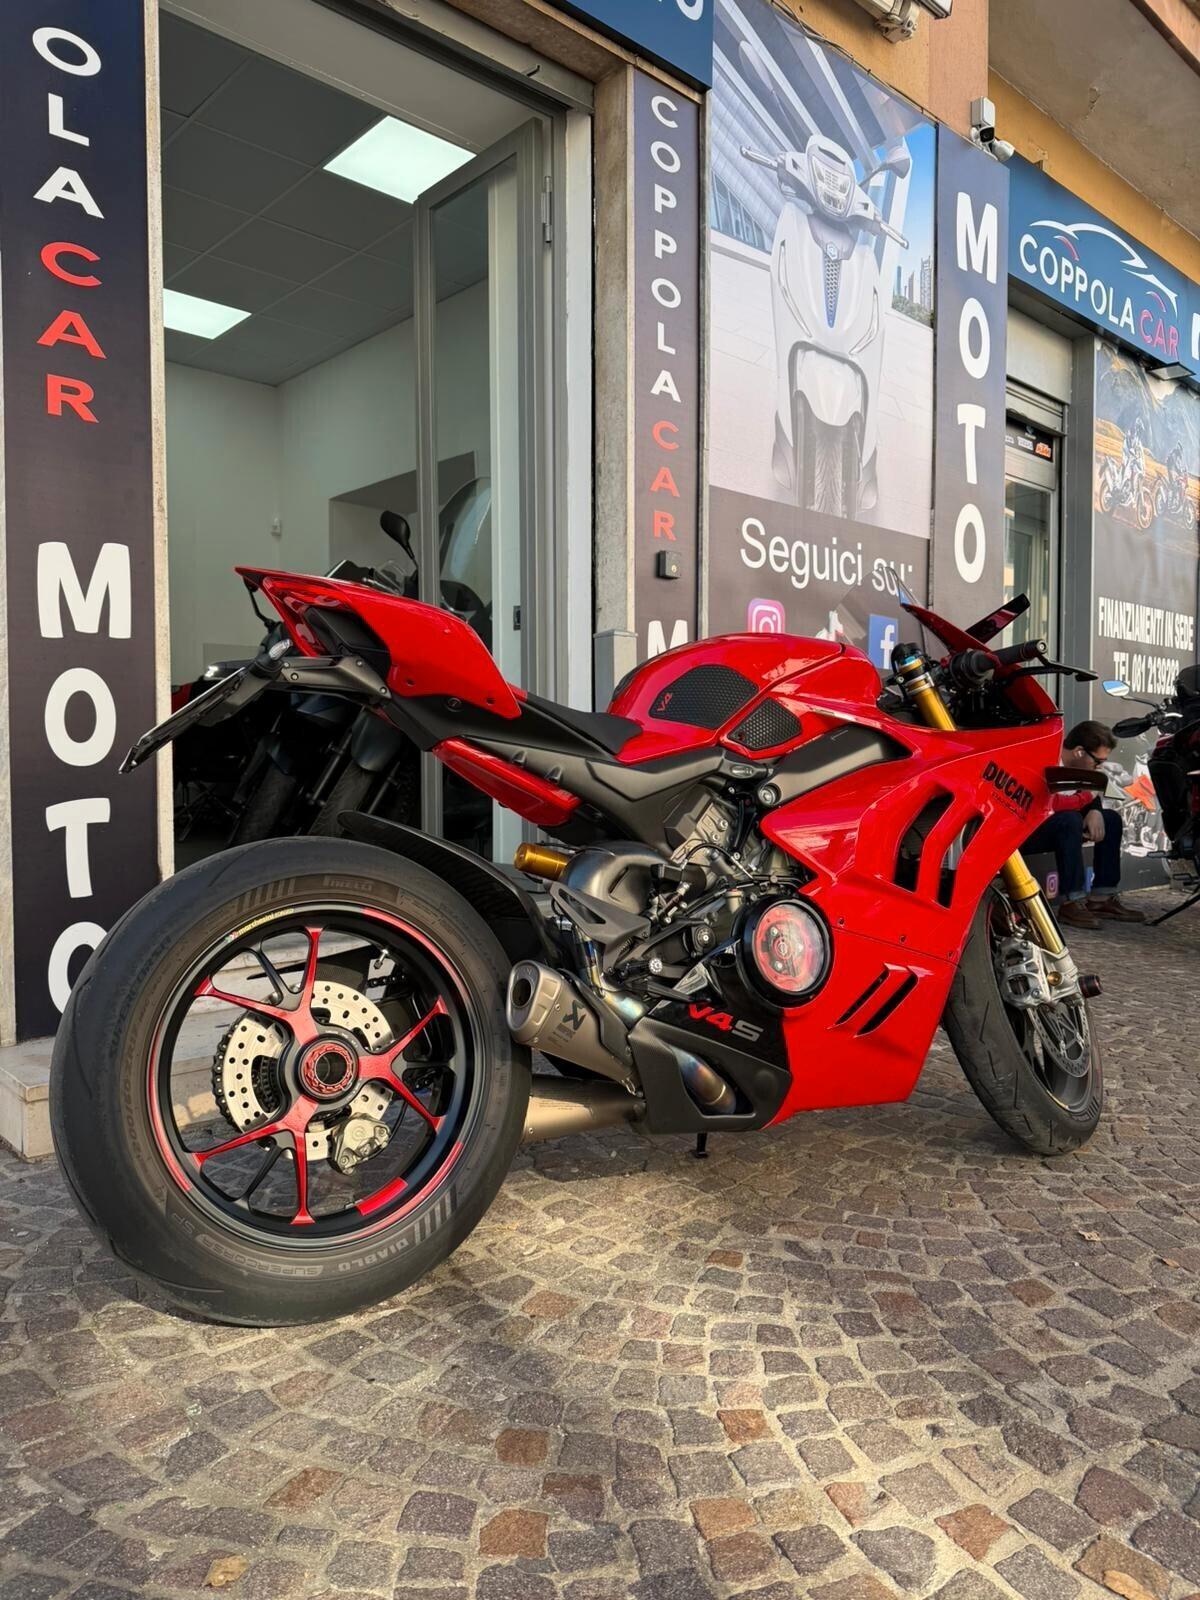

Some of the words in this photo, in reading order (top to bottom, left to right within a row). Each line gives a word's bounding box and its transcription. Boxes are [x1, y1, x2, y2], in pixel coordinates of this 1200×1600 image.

[650, 95, 682, 402] COPPOLA
[36, 241, 107, 423] CAR
[1019, 233, 1135, 335] COPPOLA
[1138, 309, 1179, 362] CAR
[954, 191, 998, 583] MOTO
[650, 420, 681, 541] CAR
[740, 517, 863, 589] Seguici
[1098, 596, 1164, 646] FINANZIAMENTI
[1165, 610, 1174, 648] IN
[1175, 612, 1194, 651] SEDE
[1113, 651, 1131, 685] TEL
[1131, 653, 1146, 693] 081
[38, 541, 131, 1014] MOTO
[982, 760, 1034, 812] DUCATI
[198, 1234, 320, 1276] SUPERCORSA
[338, 1237, 409, 1272] DIABLO
